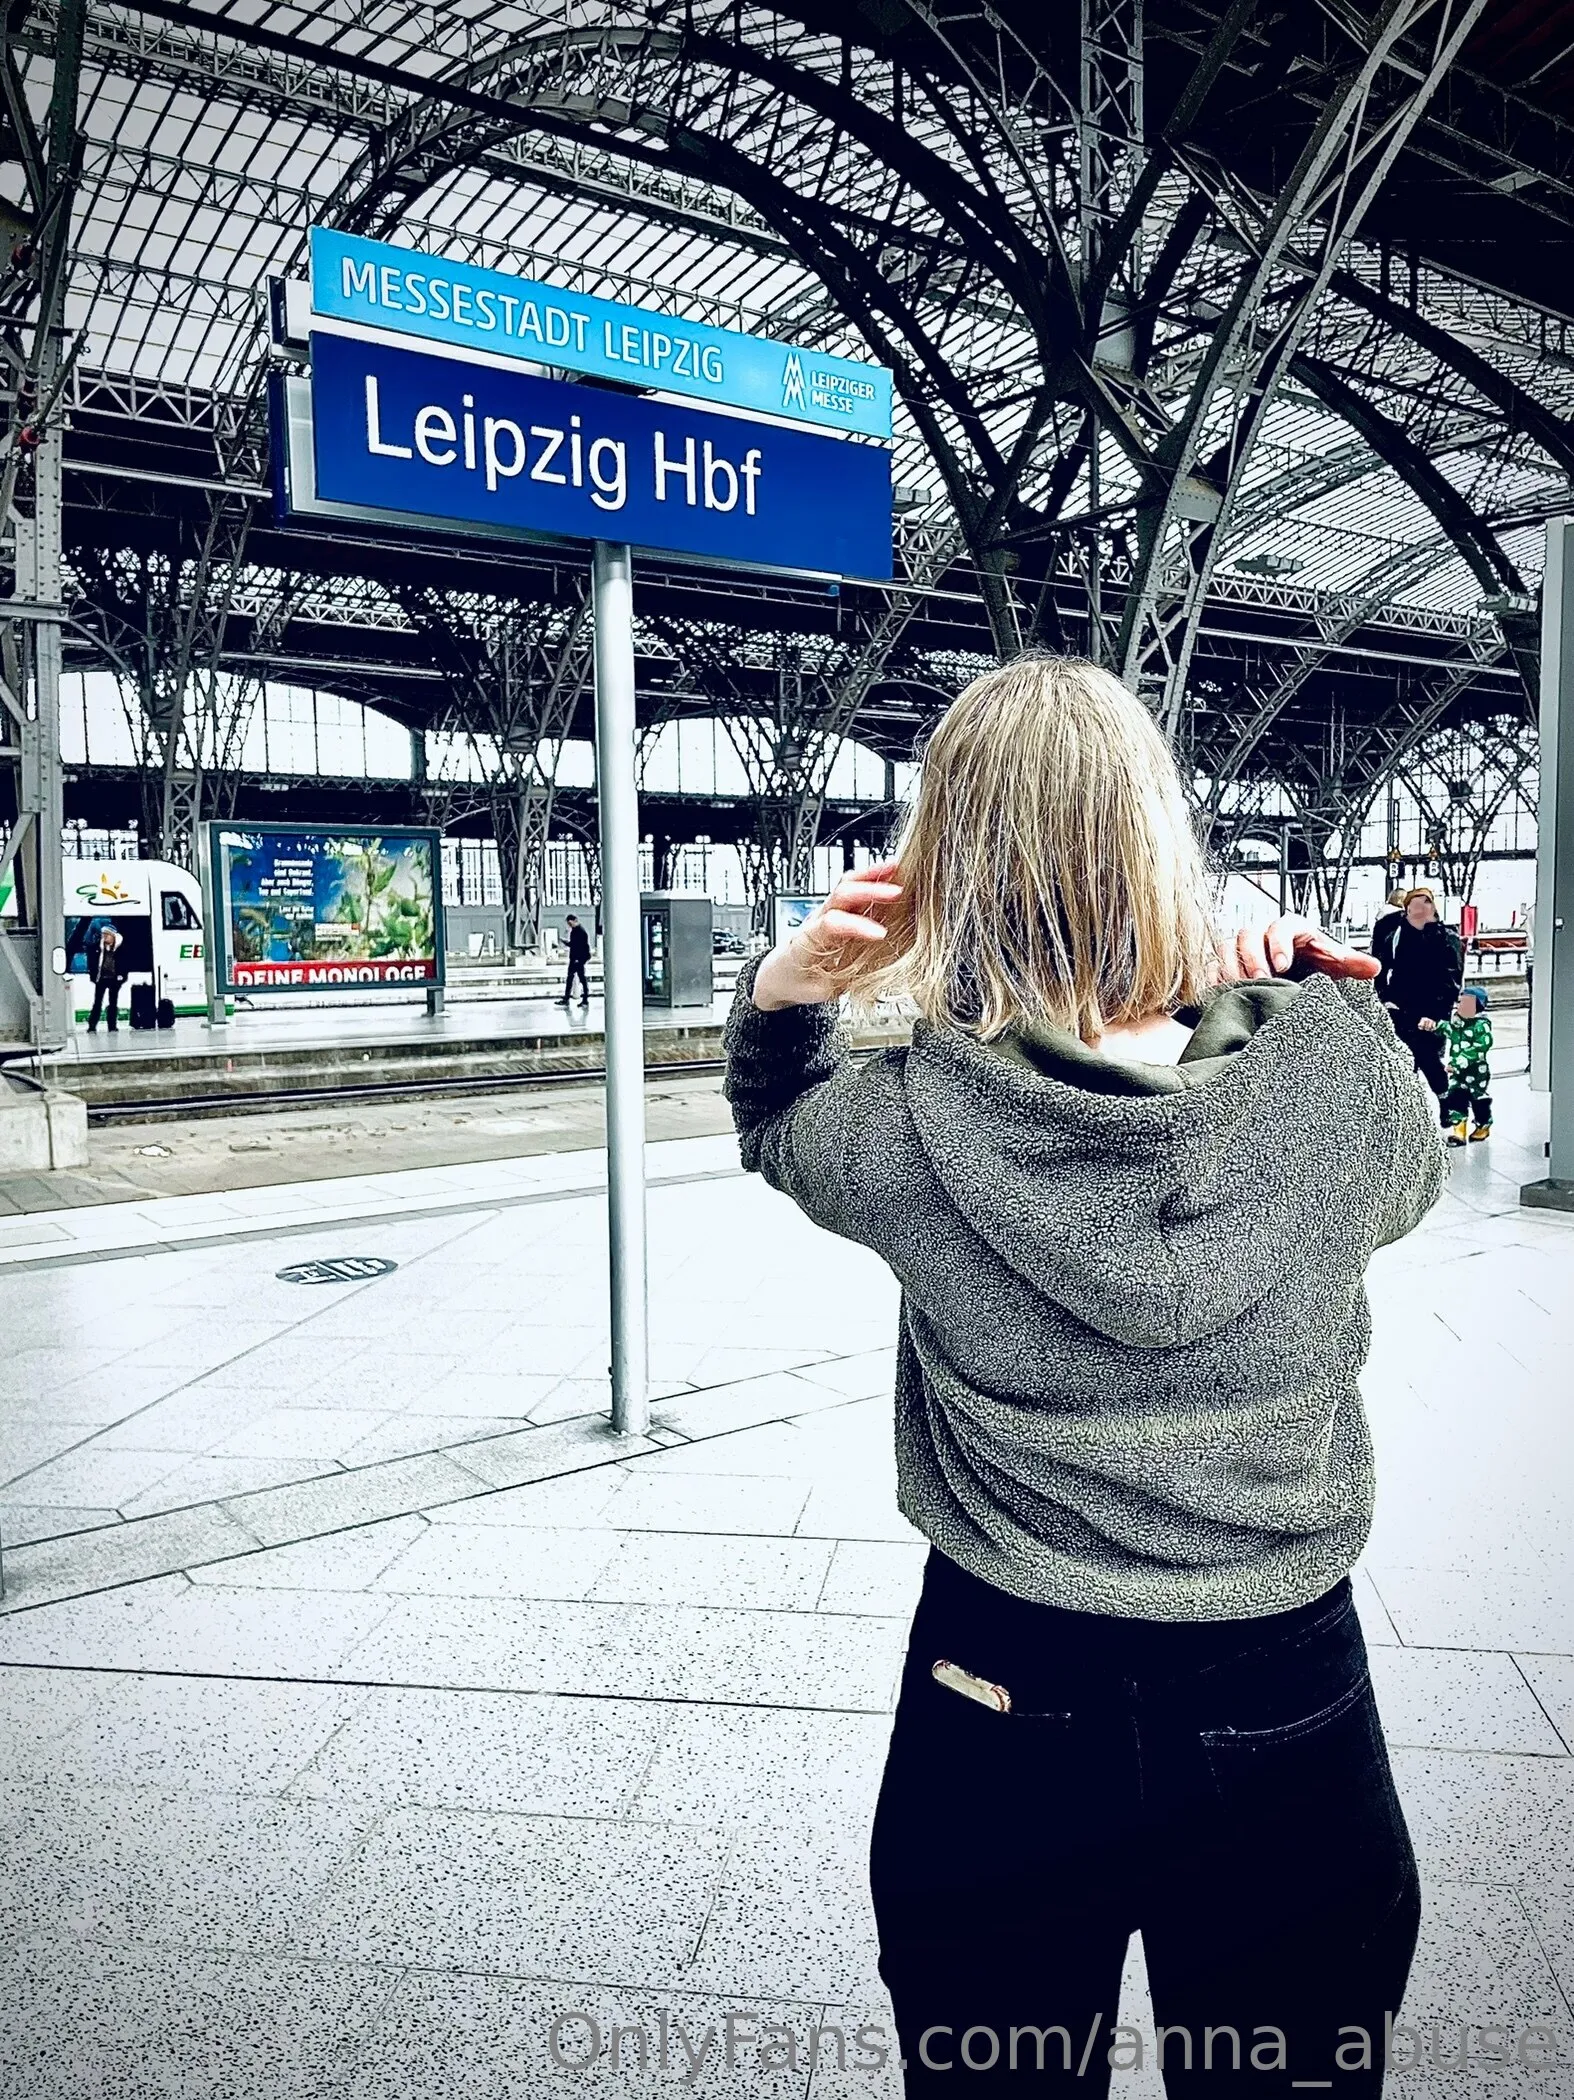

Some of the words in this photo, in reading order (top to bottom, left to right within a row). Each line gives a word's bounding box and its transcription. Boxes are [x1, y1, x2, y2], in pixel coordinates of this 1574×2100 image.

[341, 257, 590, 351] MESSESTADT
[604, 320, 724, 383] LEIPZIG
[811, 370, 875, 400] LEIPZIGER
[811, 389, 854, 414] MESSE
[365, 375, 627, 511] Leipzig
[653, 430, 762, 516] Hbf
